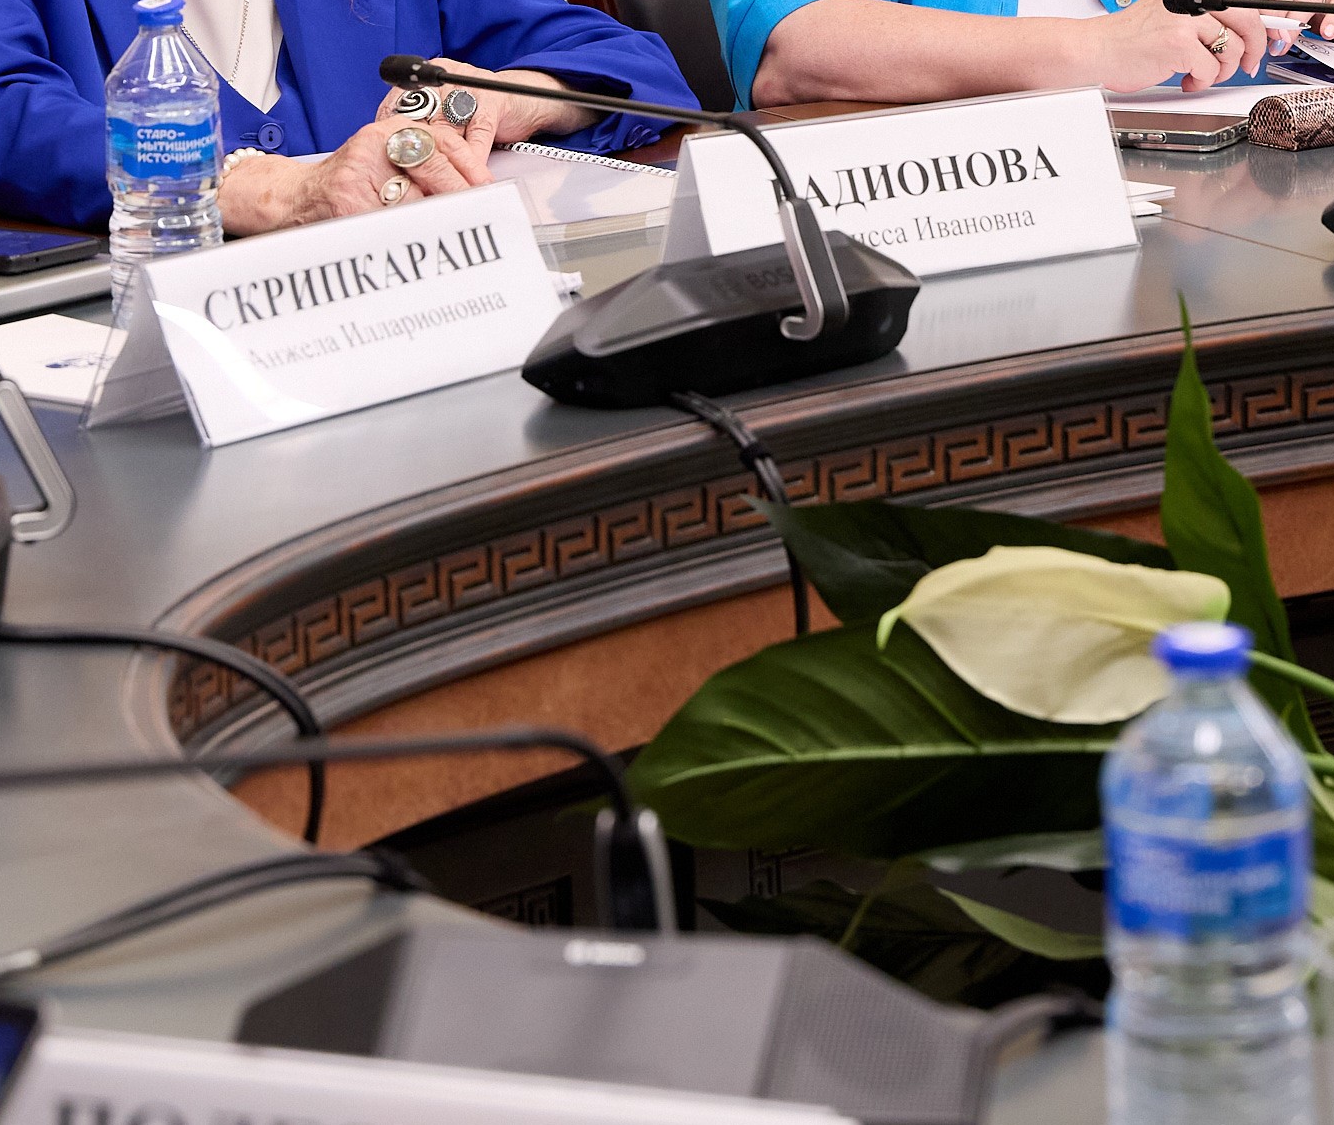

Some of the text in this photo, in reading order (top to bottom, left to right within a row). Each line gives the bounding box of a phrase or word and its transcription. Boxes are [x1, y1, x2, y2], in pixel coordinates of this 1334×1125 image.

[137, 134, 218, 151] МЫТИЩИНСК
[137, 150, 202, 164] ИСТОЧНИК
[913, 208, 1036, 242] Ивановна
[204, 224, 503, 331] СКРИПКАРАШ
[248, 291, 507, 370] Анжела Илларионовна
